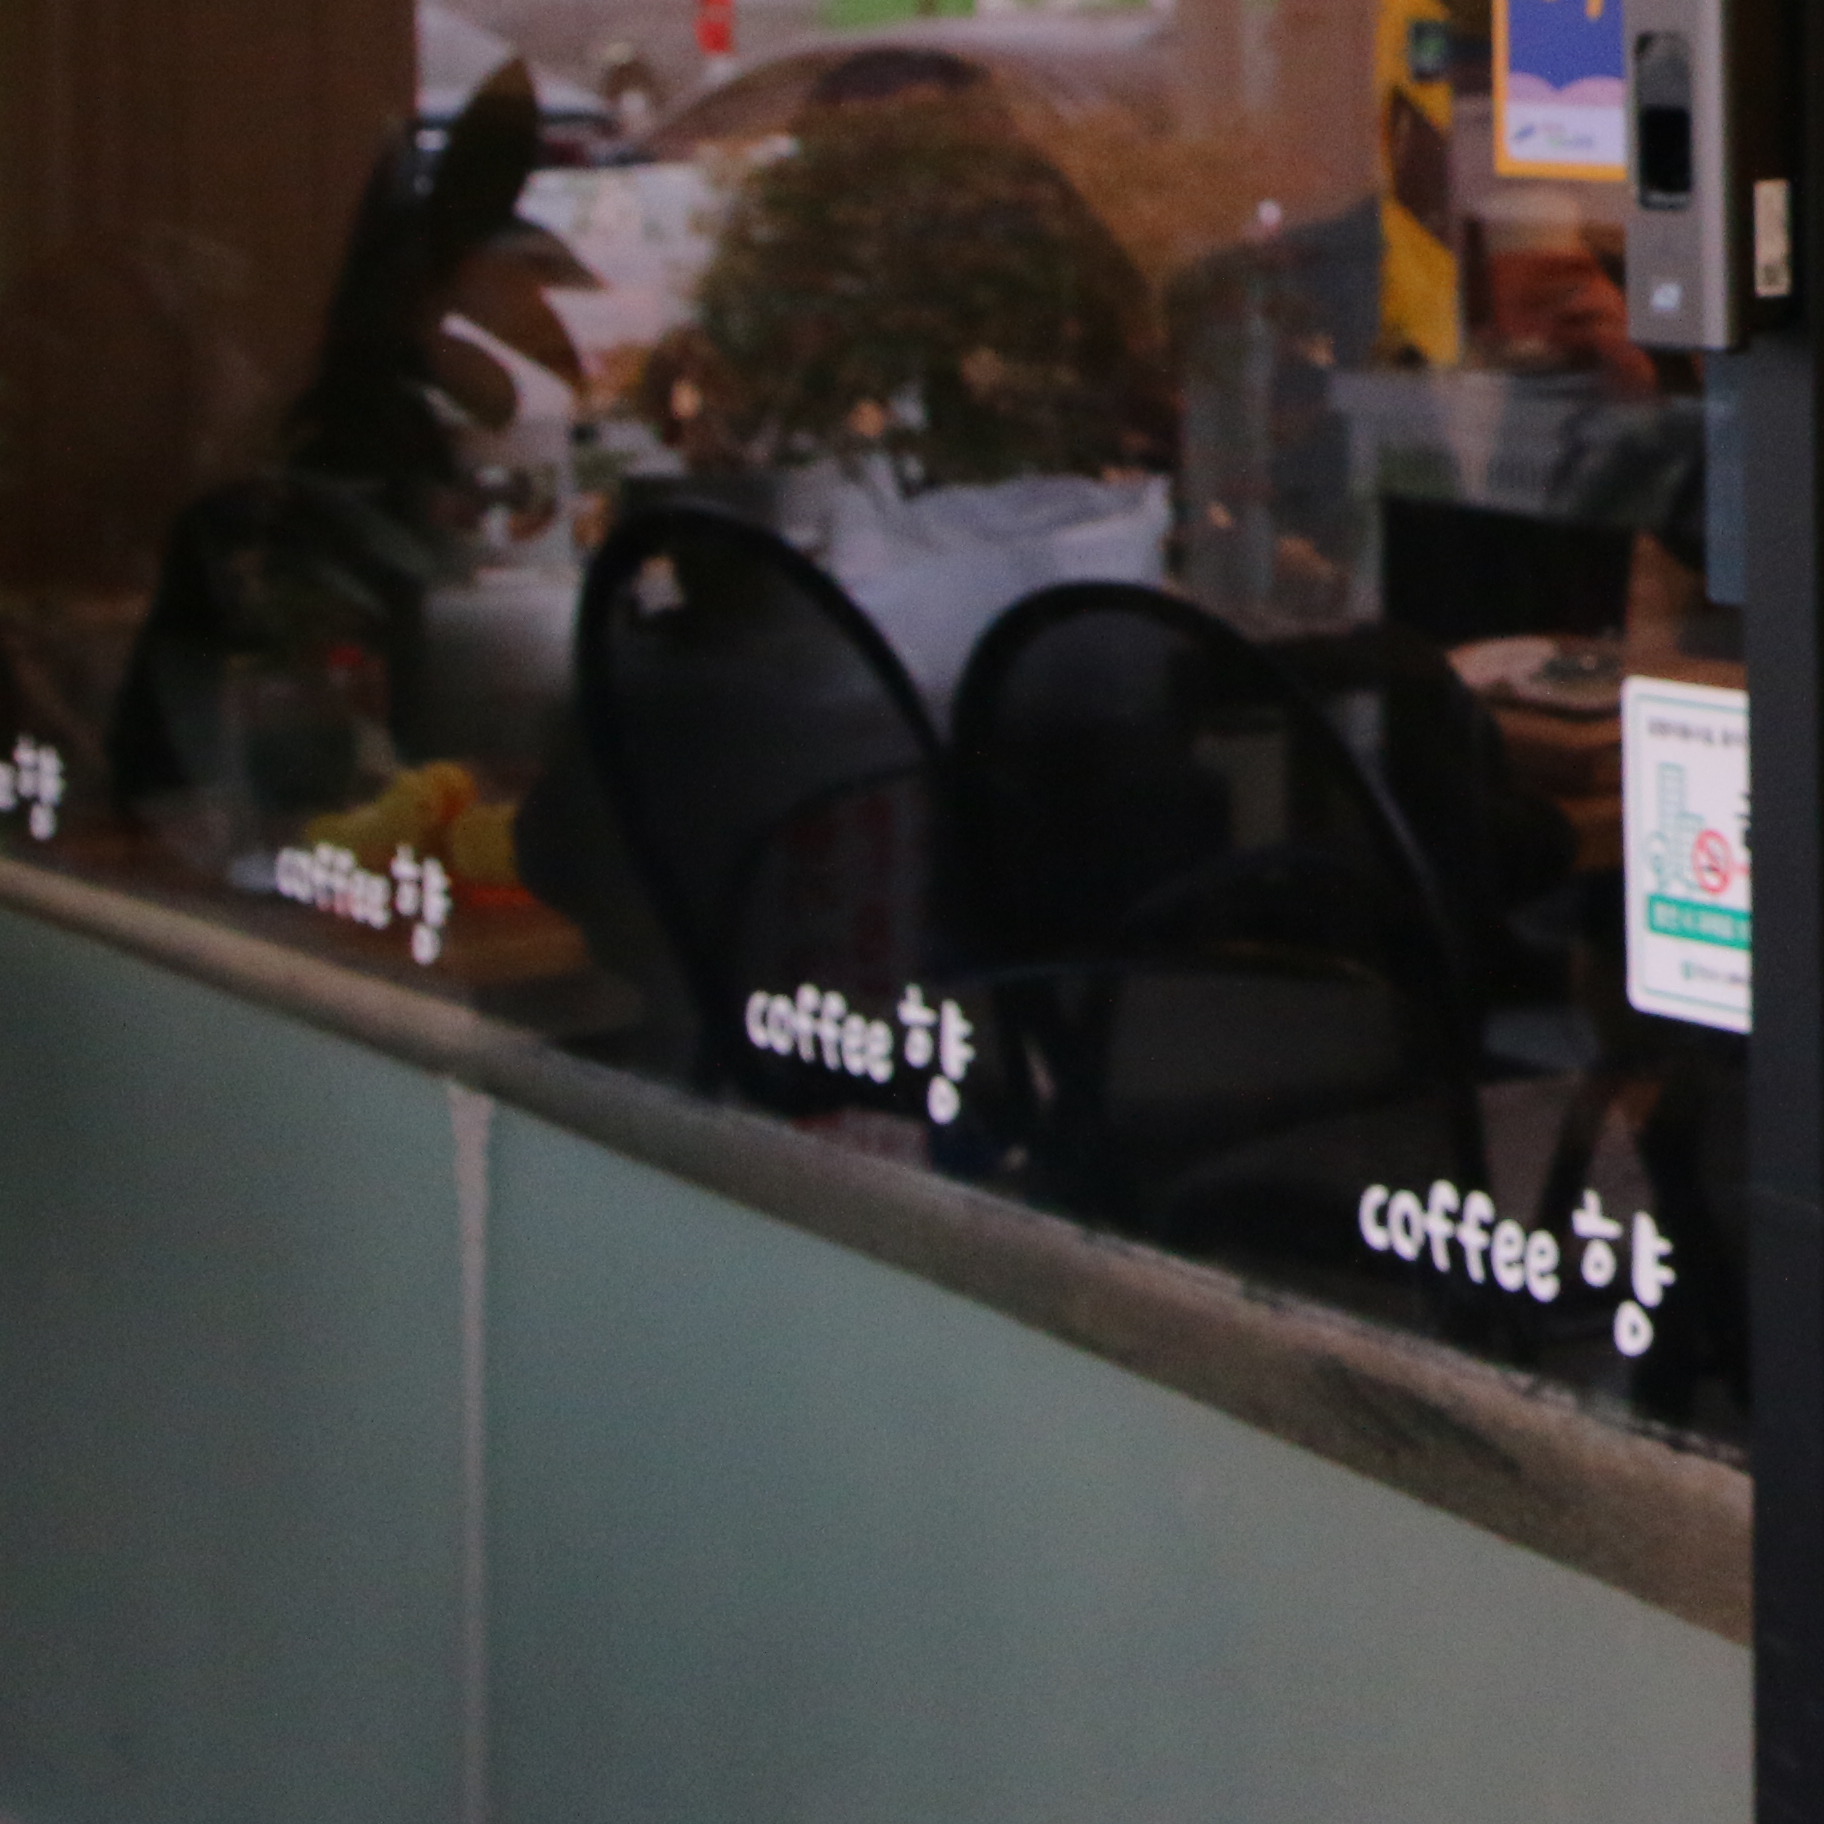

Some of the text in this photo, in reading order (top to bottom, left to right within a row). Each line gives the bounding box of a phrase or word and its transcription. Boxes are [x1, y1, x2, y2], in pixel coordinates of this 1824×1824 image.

[744, 983, 975, 1124] coffee 향
[1359, 1179, 1675, 1357] coffee 향
